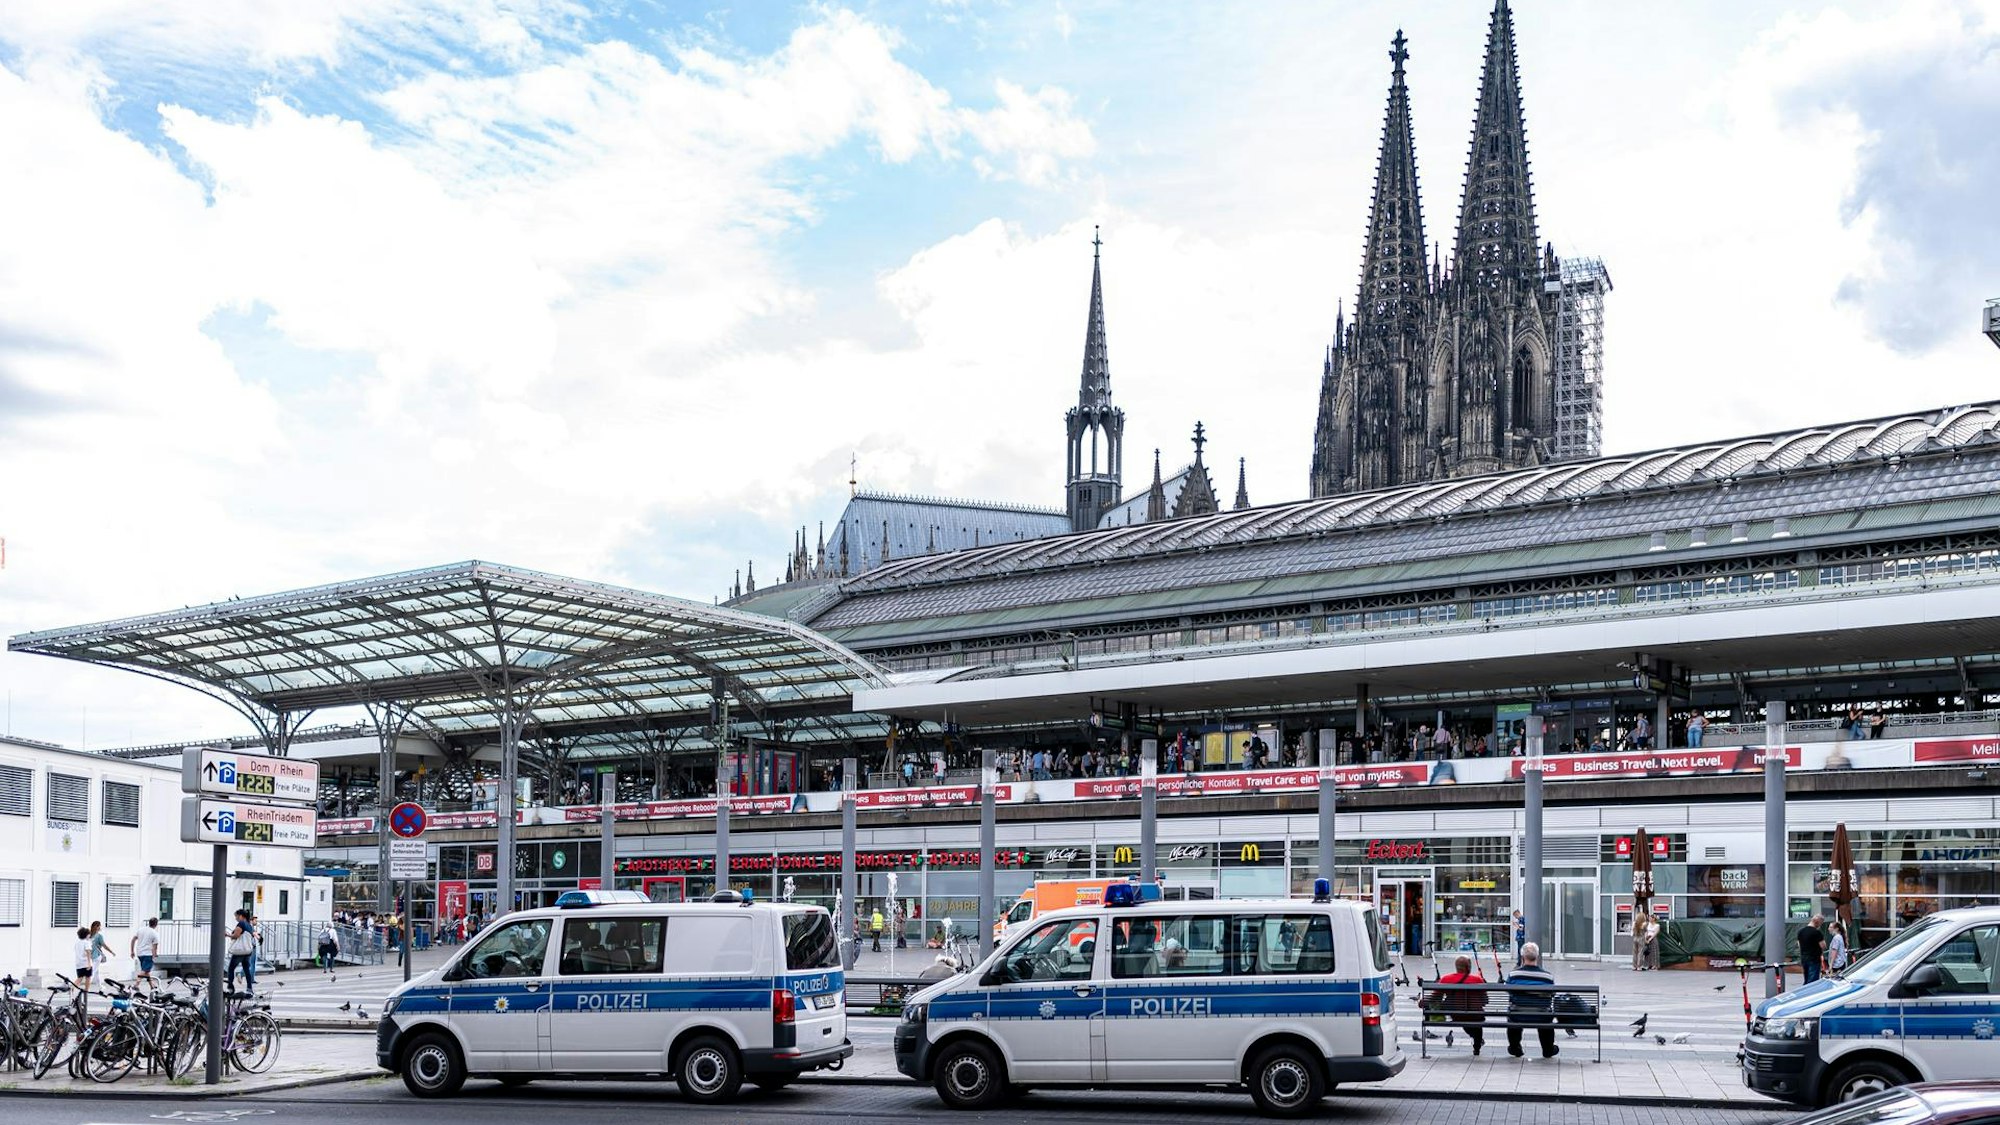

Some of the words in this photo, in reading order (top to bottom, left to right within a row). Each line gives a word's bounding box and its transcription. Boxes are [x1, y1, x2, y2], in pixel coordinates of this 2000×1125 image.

[250, 761, 270, 774] Dom
[273, 764, 278, 774] /
[280, 764, 304, 776] Rhein
[1574, 762, 1619, 772] Business
[1622, 760, 1658, 770] Travel.
[1661, 758, 1688, 768] Next
[1690, 756, 1724, 766] Level.
[237, 774, 273, 794] 1226
[276, 782, 290, 792] freie
[292, 783, 310, 794] Plätze
[1094, 784, 1112, 794] Rund
[1128, 782, 1140, 792] die
[1158, 778, 1206, 790] persönlicher
[1208, 778, 1242, 788] Kontakt.
[1246, 776, 1272, 786] Travel
[1275, 775, 1296, 786] Care:
[1300, 774, 1314, 784] ein
[1348, 772, 1365, 782] von
[1368, 770, 1404, 783] myHRS.
[878, 794, 906, 803] Business
[907, 794, 930, 802] Travel.
[930, 792, 946, 800] Next
[948, 790, 967, 800] Level.
[248, 808, 303, 824] RheinTriadem
[654, 803, 692, 814] Automatisches
[734, 802, 752, 810] Vorteil
[433, 817, 452, 825] Business
[244, 824, 271, 842] 224
[274, 830, 289, 838] freie
[290, 830, 309, 840] Plätze
[478, 856, 491, 868] DB
[554, 852, 564, 868] S
[628, 858, 692, 872] APOTHEKE
[712, 854, 818, 872] IERNATIONAL
[824, 853, 904, 869] PHRMACY
[930, 851, 1011, 867] APOTHKE
[1722, 870, 1748, 880] back
[794, 978, 823, 994] POLIZEI
[577, 994, 647, 1010] POLIZEI
[1130, 998, 1212, 1015] POLIZEI
